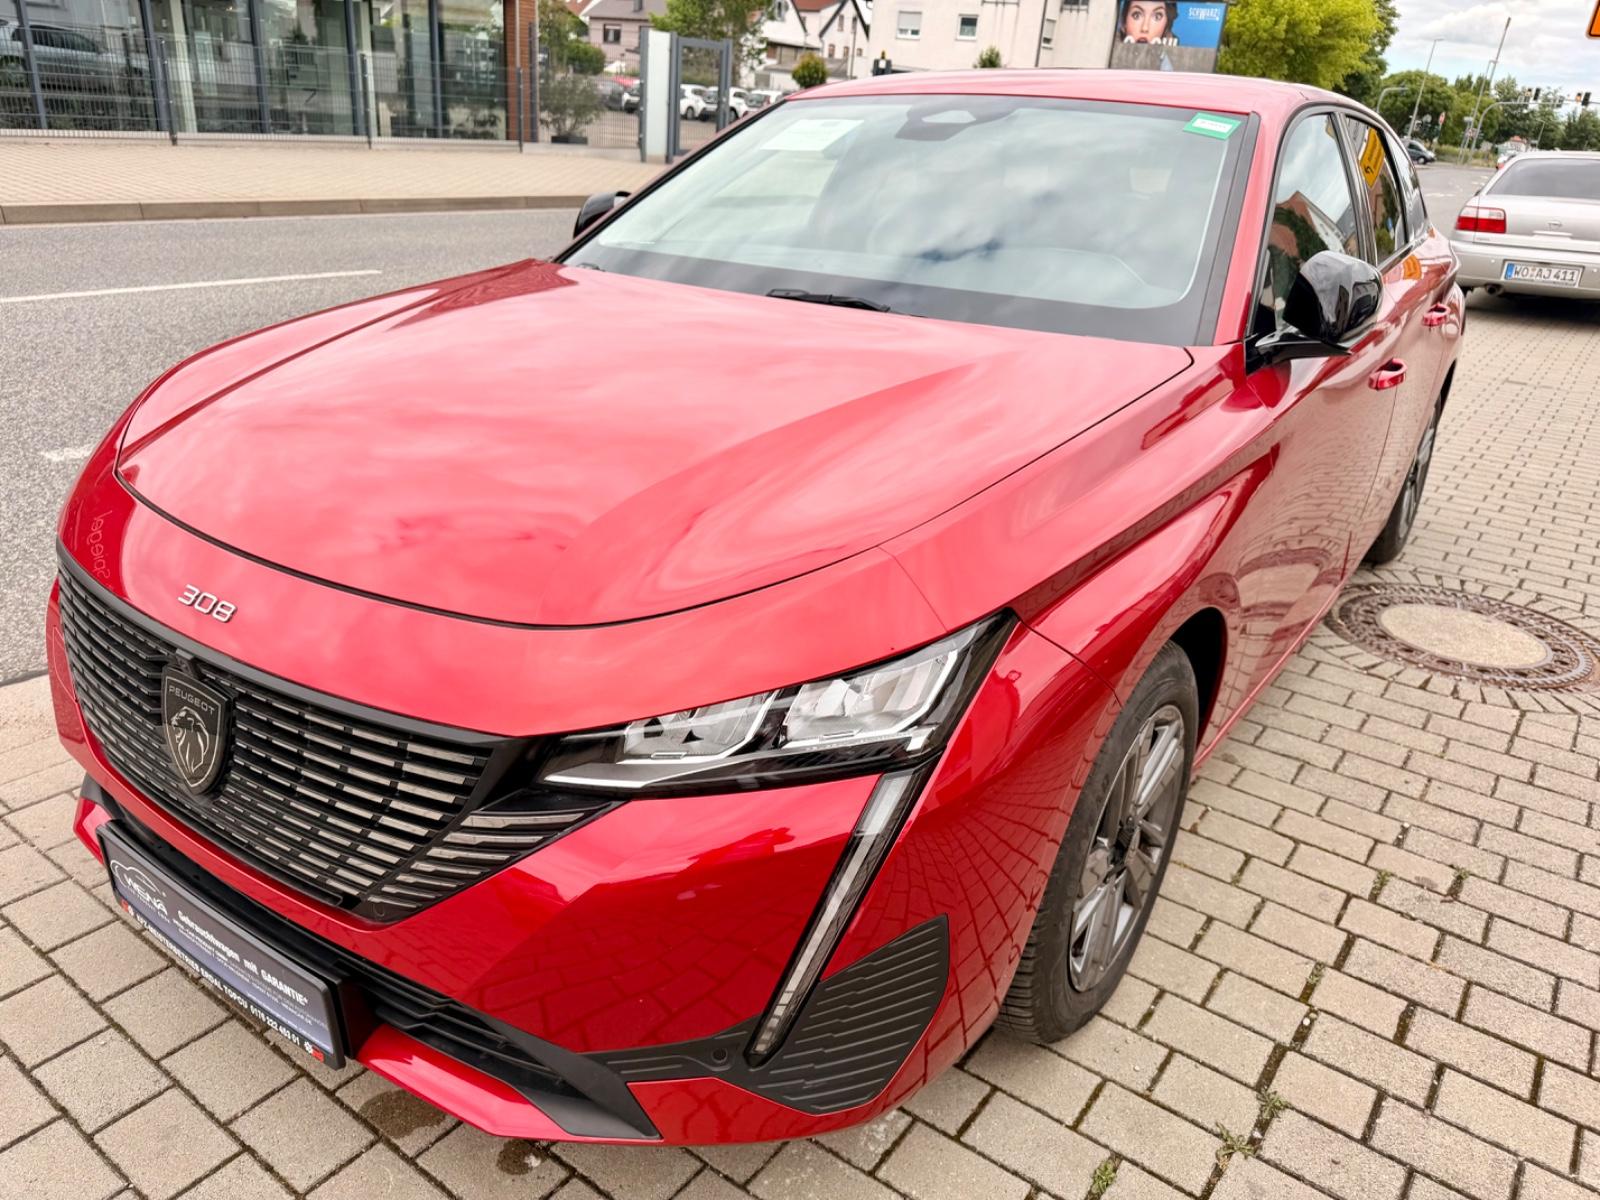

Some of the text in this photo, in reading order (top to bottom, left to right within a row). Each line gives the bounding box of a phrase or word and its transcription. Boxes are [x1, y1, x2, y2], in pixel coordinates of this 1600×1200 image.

[1514, 263, 1576, 282] WO AJ 411
[177, 584, 237, 623] 308
[168, 685, 215, 715] PEUGEOT
[177, 910, 240, 962] Gebrauchtwagen
[243, 958, 259, 976] mit
